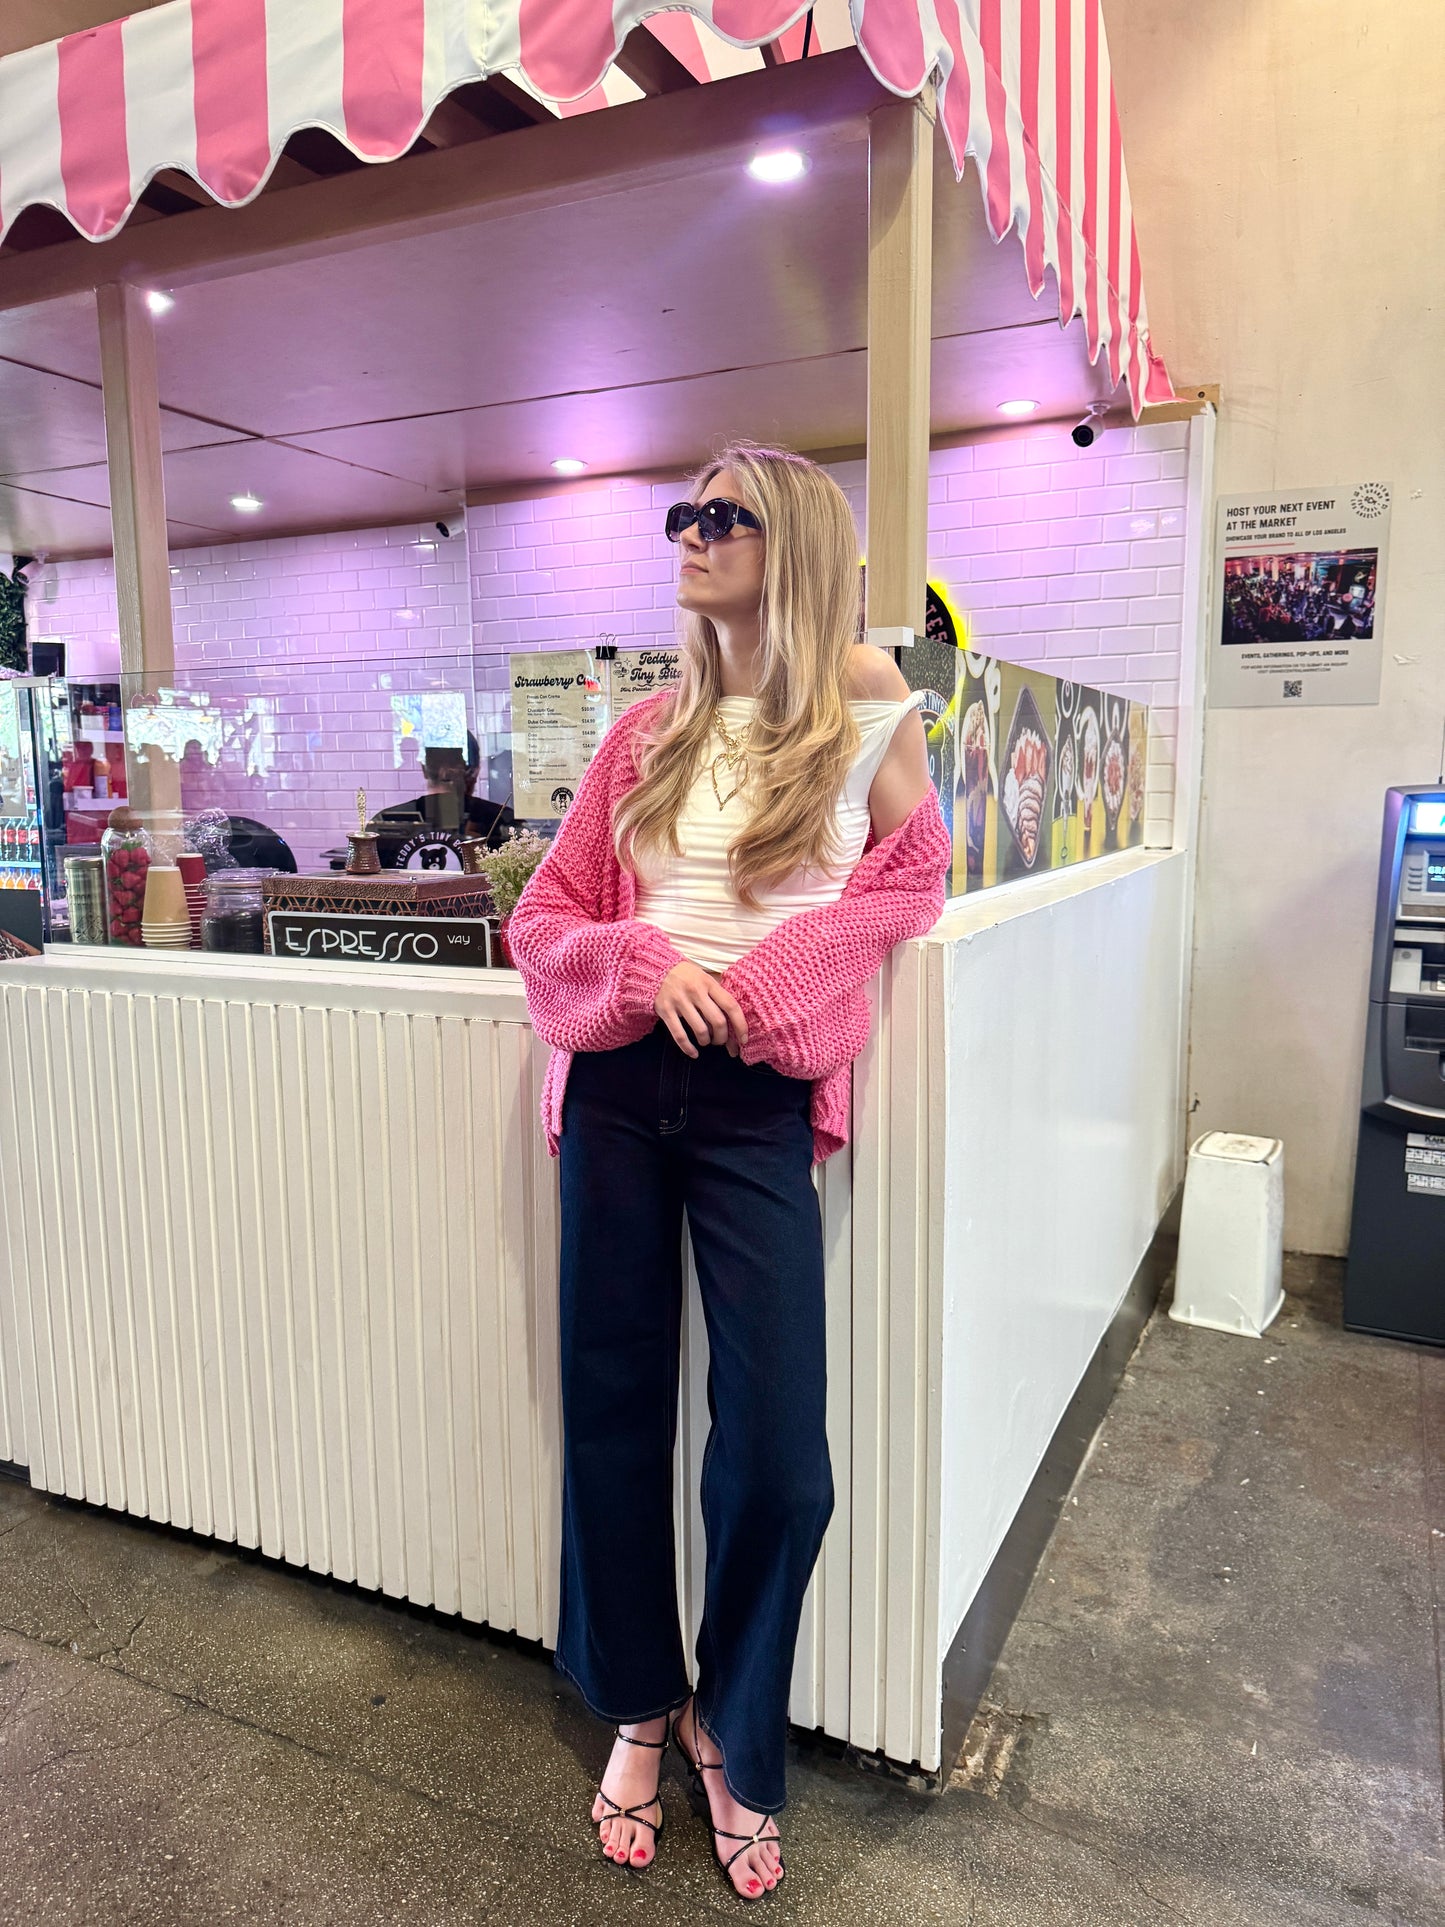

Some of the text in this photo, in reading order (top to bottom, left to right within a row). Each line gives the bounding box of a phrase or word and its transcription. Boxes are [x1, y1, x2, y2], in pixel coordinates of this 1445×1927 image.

[1226, 500, 1336, 517] HOST YOUR NEXT EVENT
[1226, 516, 1297, 531] AT THE MARKET
[638, 652, 679, 668] Teddys
[514, 675, 574, 690] Strawberry
[630, 667, 684, 684] Tiny Bite
[396, 832, 452, 866] TEDDY'S TINY
[284, 926, 472, 962] ESPRESSO VAY
